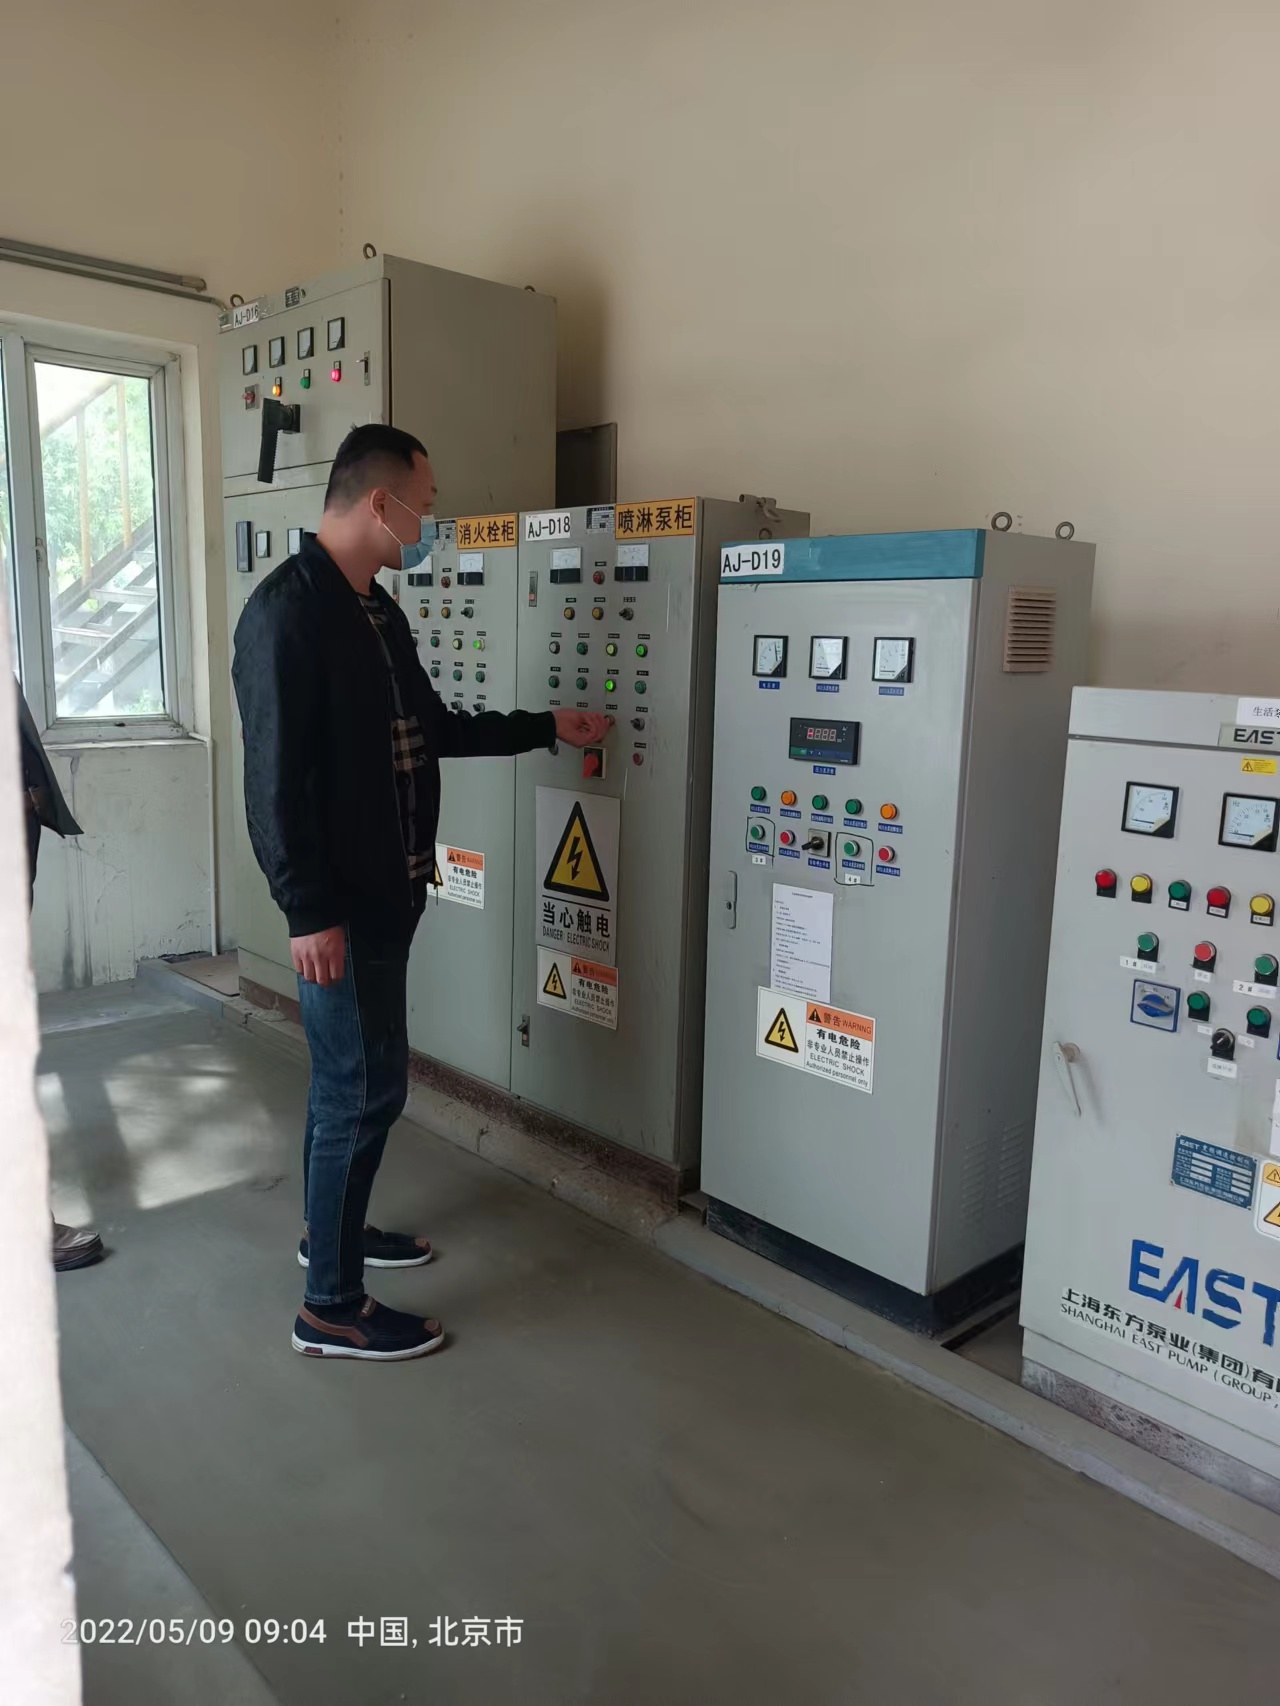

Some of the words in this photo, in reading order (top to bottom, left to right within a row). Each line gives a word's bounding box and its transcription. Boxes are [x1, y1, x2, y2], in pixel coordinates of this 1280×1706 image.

[234, 304, 259, 327] AJ-D16
[527, 515, 571, 539] AJ-D18
[617, 504, 693, 534] 喷淋泵柜
[458, 520, 515, 545] 消火栓柜
[722, 549, 781, 573] AJ-D19
[1233, 728, 1280, 745] EAS
[542, 901, 611, 938] 当心触电
[542, 925, 564, 941] DANGER
[567, 932, 591, 948] ELECTRIC
[591, 938, 610, 952] SHOCK
[823, 1012, 841, 1027] 警告
[816, 1028, 861, 1051] 有电危险
[807, 1039, 870, 1067] 非专业人员禁止操作
[809, 1052, 840, 1068] ELECTRIC
[842, 1063, 865, 1076] SHOCK
[806, 1060, 832, 1075] Authorized
[832, 1069, 857, 1083] personnel
[857, 1078, 868, 1087] only
[1179, 1138, 1200, 1150] EAST
[1128, 1239, 1280, 1348] EAST
[1060, 1303, 1126, 1339] SHANGHAI
[1132, 1333, 1162, 1354] EAST
[1168, 1349, 1208, 1375] PUMP
